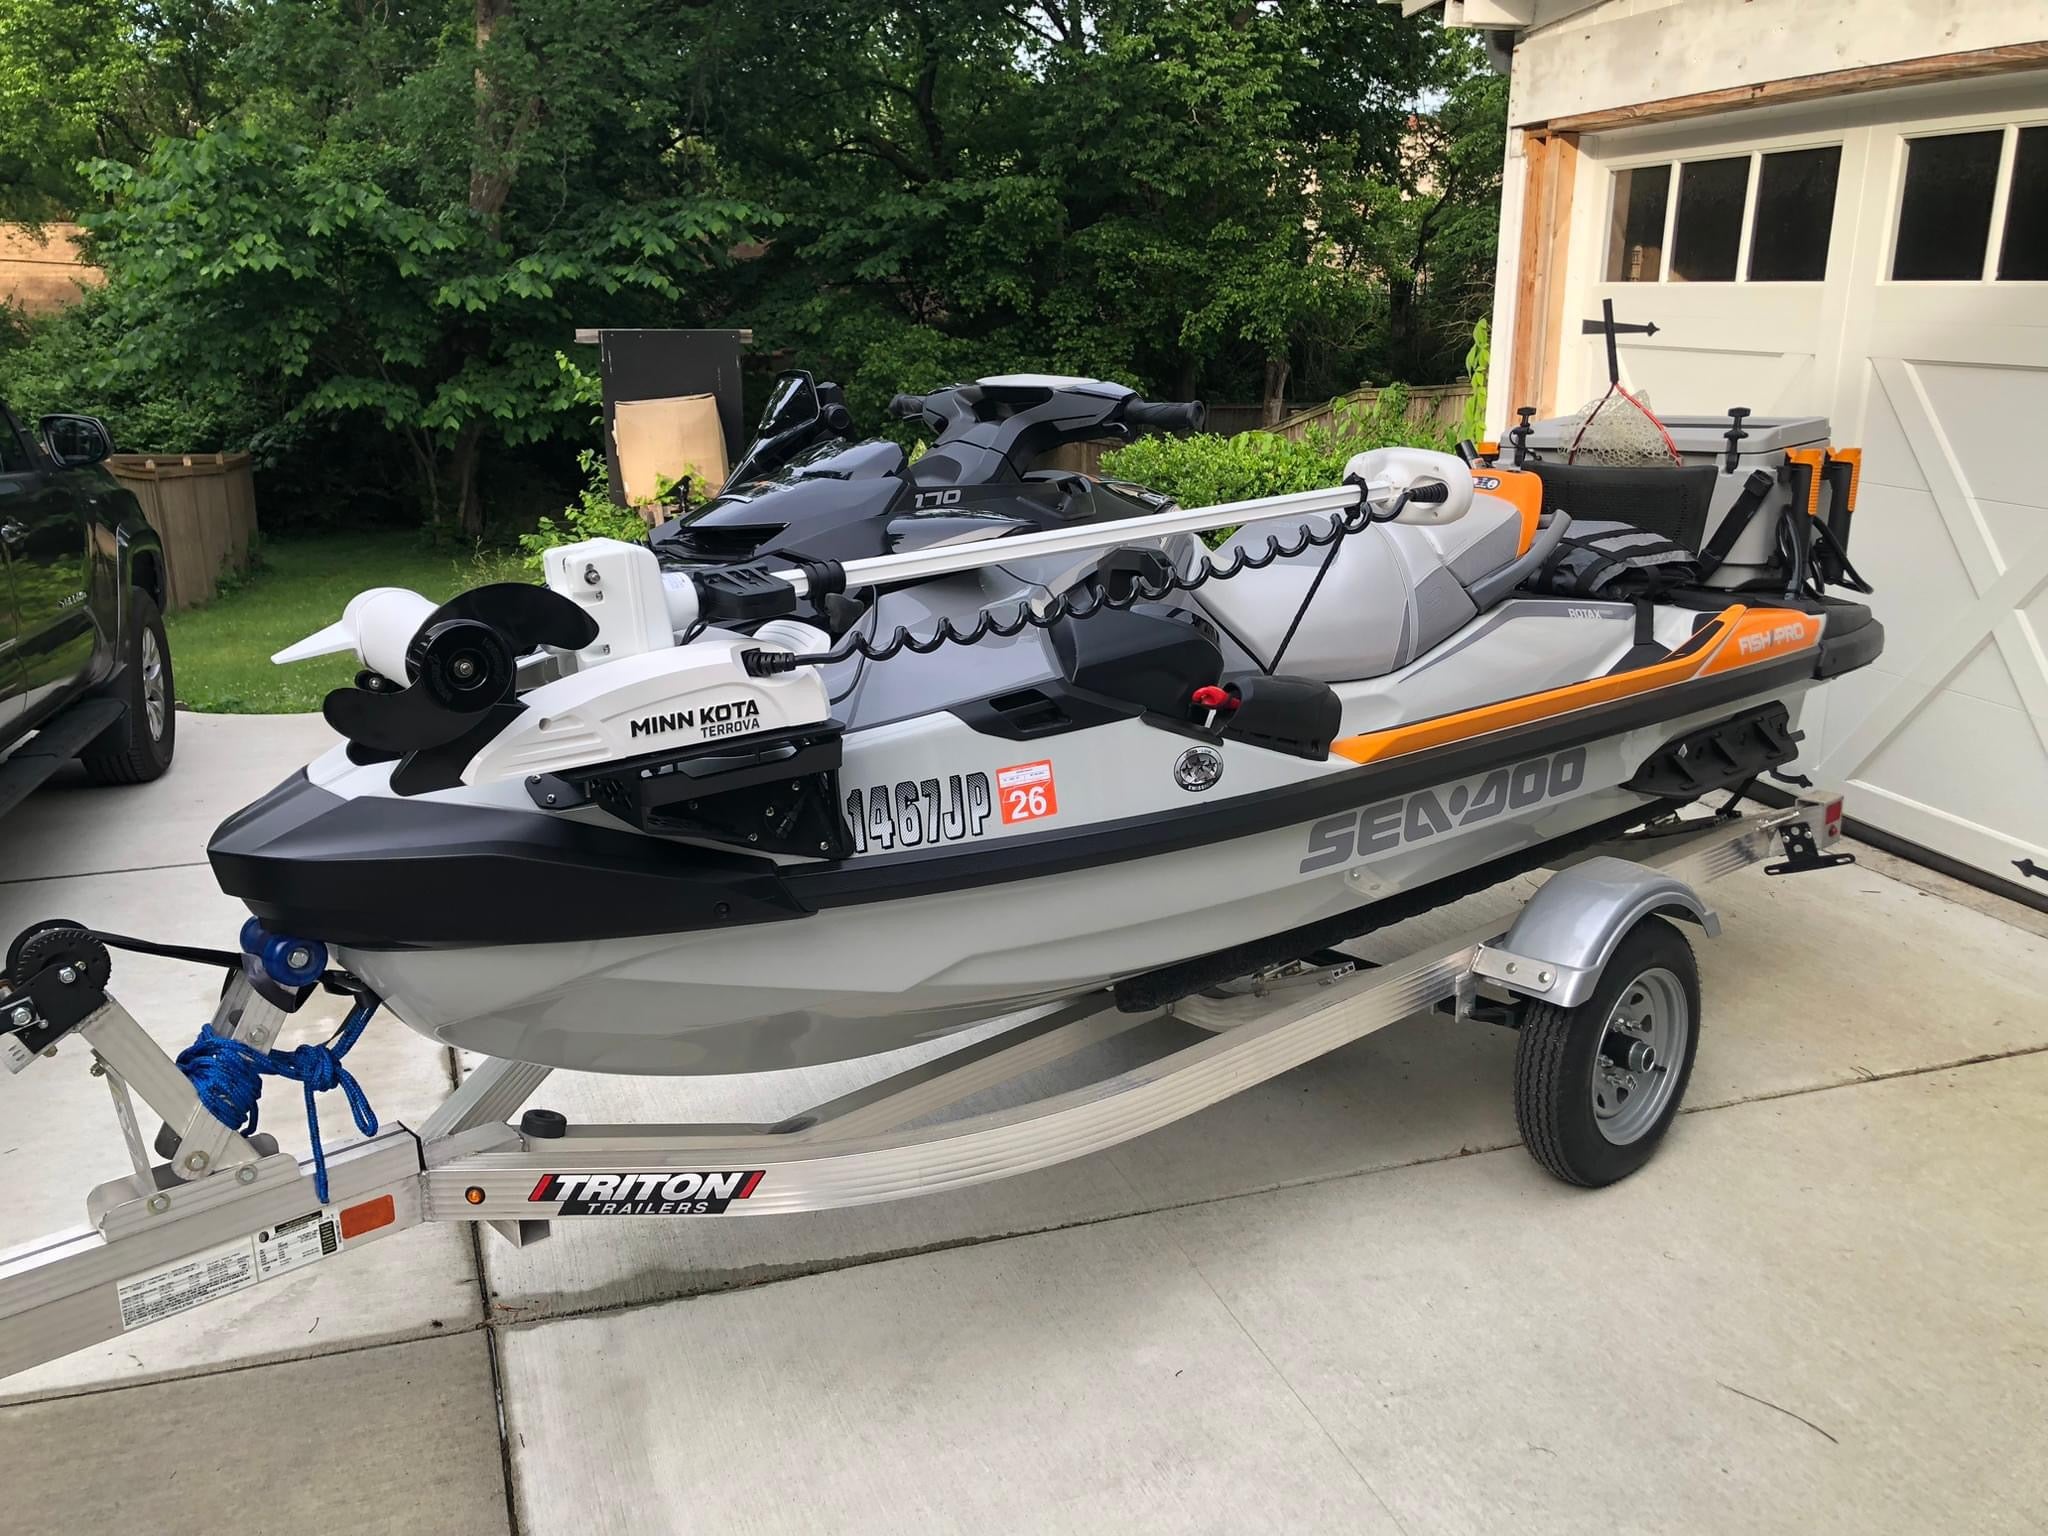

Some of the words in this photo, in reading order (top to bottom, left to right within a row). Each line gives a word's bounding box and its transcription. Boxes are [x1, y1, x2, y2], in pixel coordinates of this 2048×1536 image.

[914, 489, 962, 509] 170
[1567, 607, 1602, 620] ROTAX
[1773, 621, 1805, 645] PRO
[630, 710, 695, 738] MINN
[700, 699, 760, 725] KOTA
[701, 718, 760, 738] TERROVA
[847, 771, 992, 854] 1467JP
[1009, 786, 1048, 820] 26
[555, 1172, 744, 1201] TRITON
[587, 1201, 709, 1215] TRAILERS
